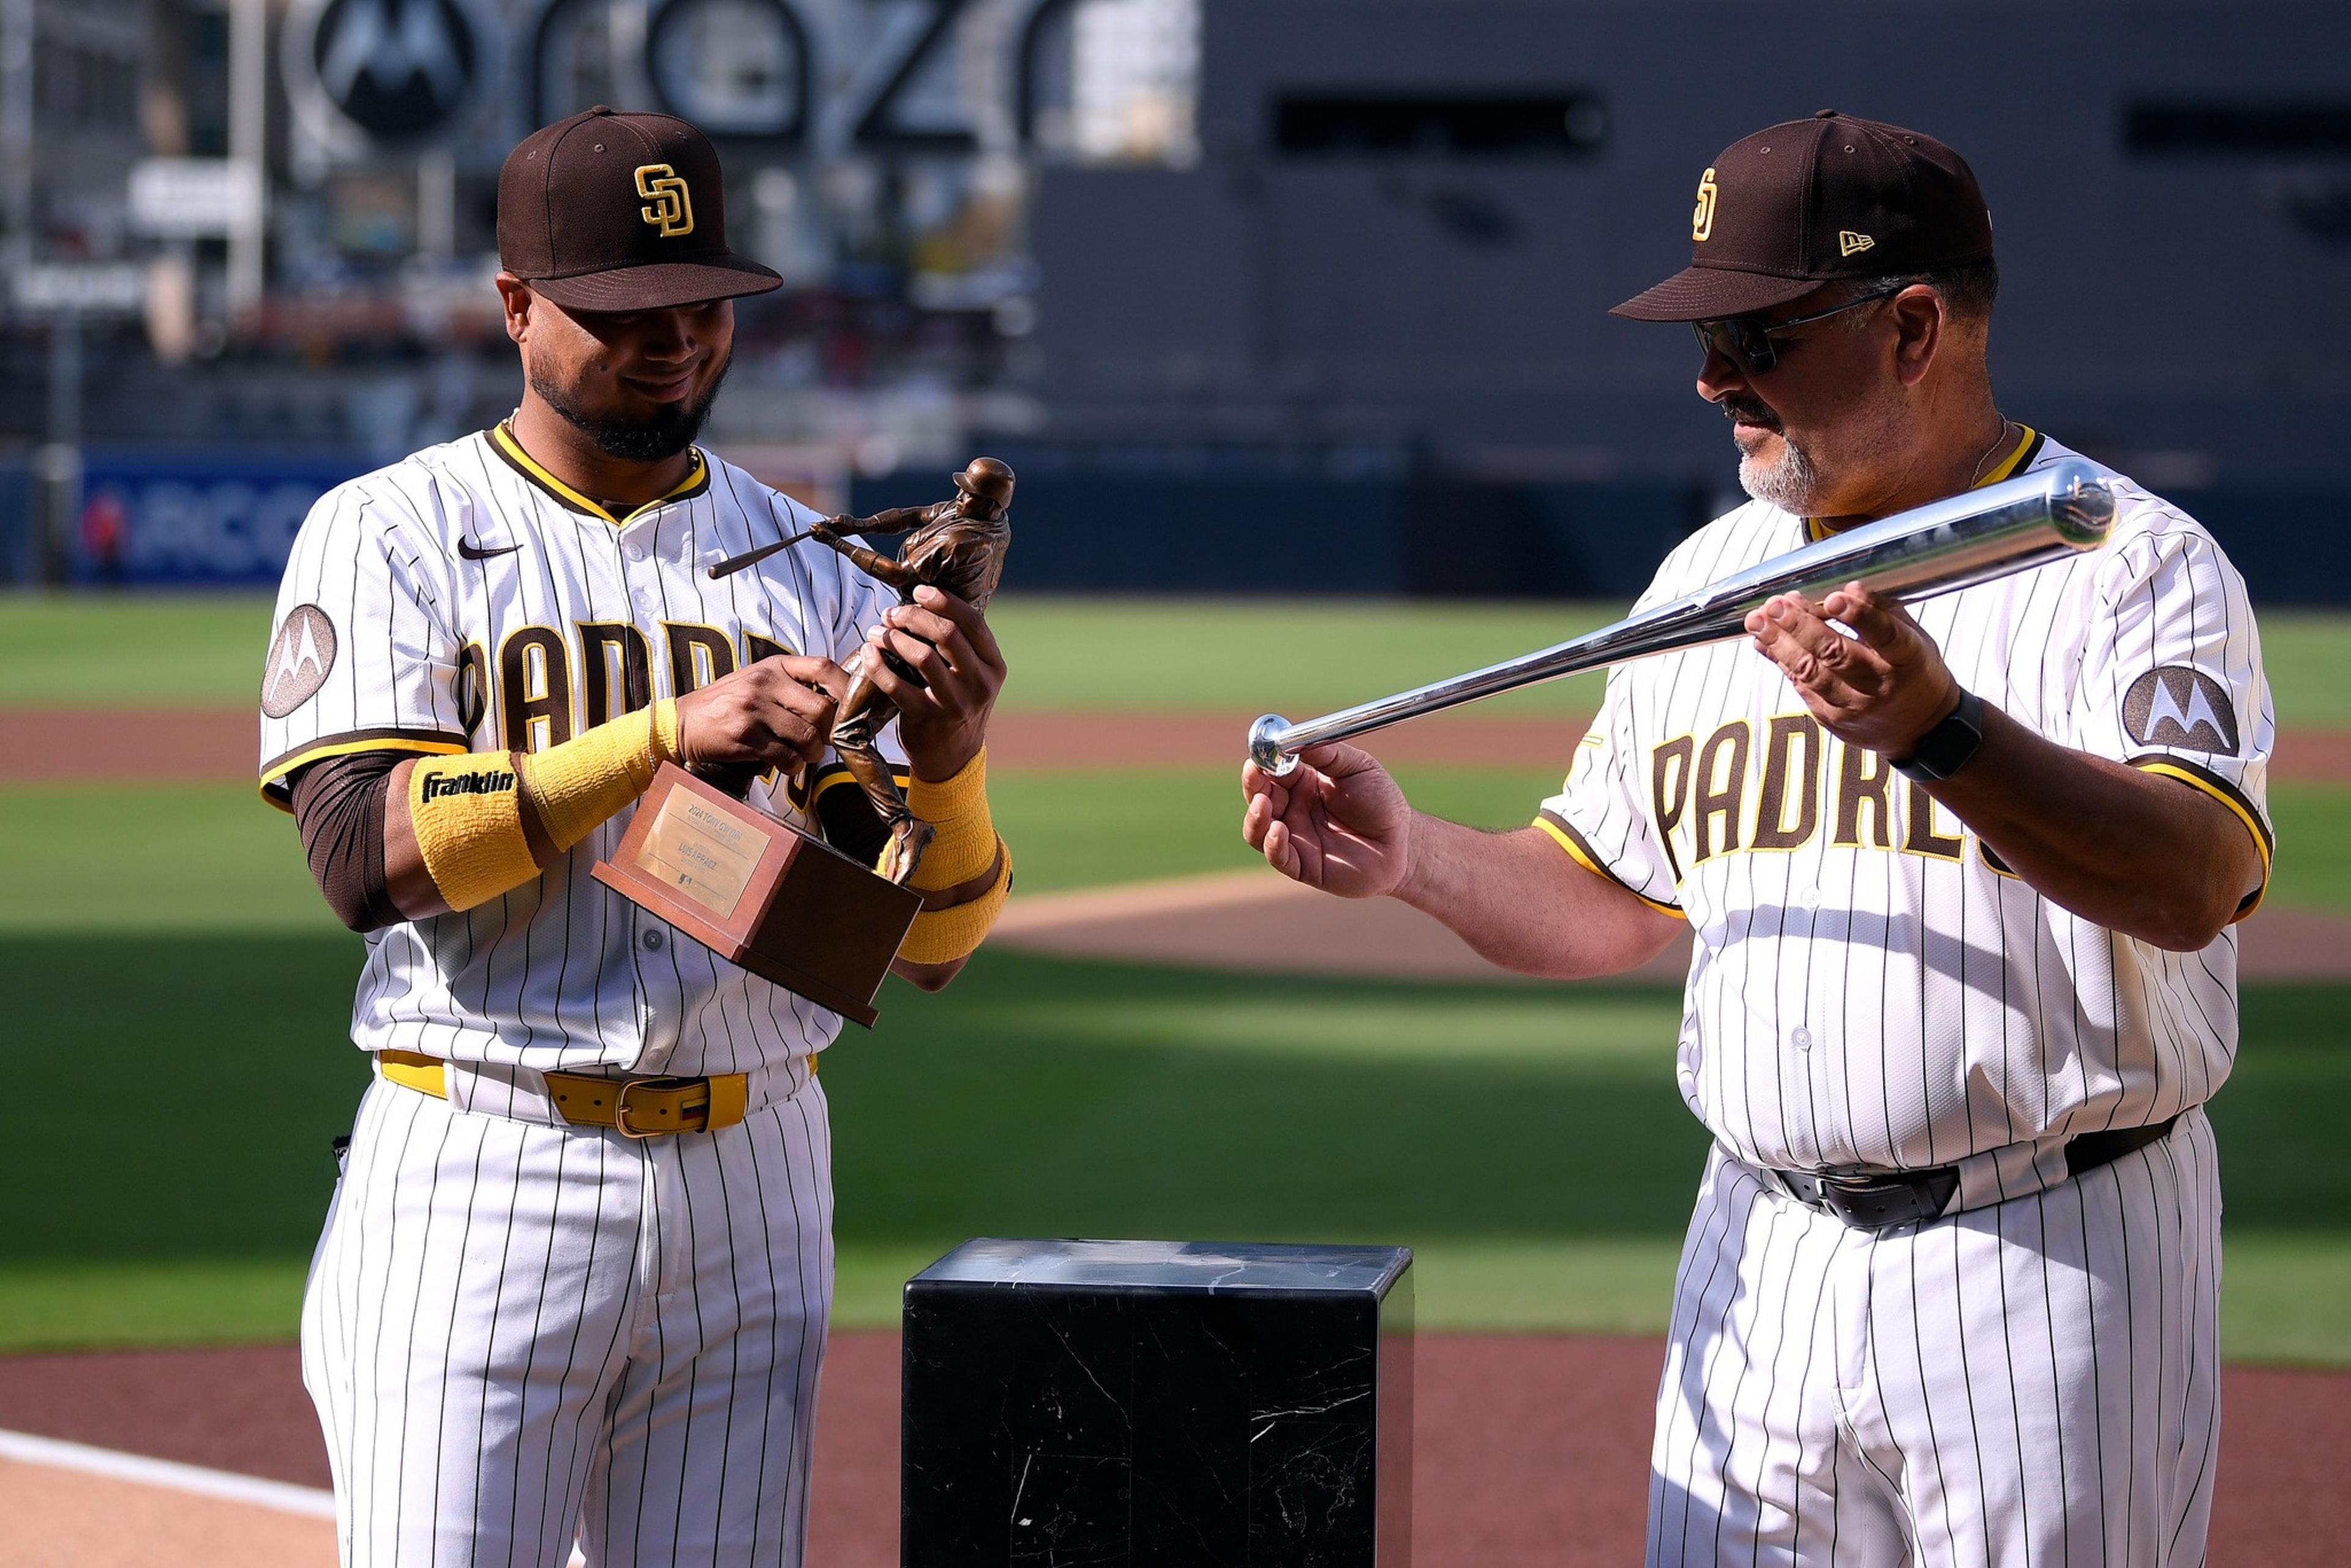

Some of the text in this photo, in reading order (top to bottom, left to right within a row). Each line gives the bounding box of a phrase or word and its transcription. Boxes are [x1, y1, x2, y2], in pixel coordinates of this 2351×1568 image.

[1652, 712, 2023, 889] PADR
[688, 804, 704, 819] 2024
[702, 812, 720, 828] TONY
[677, 842, 693, 857] LUIS
